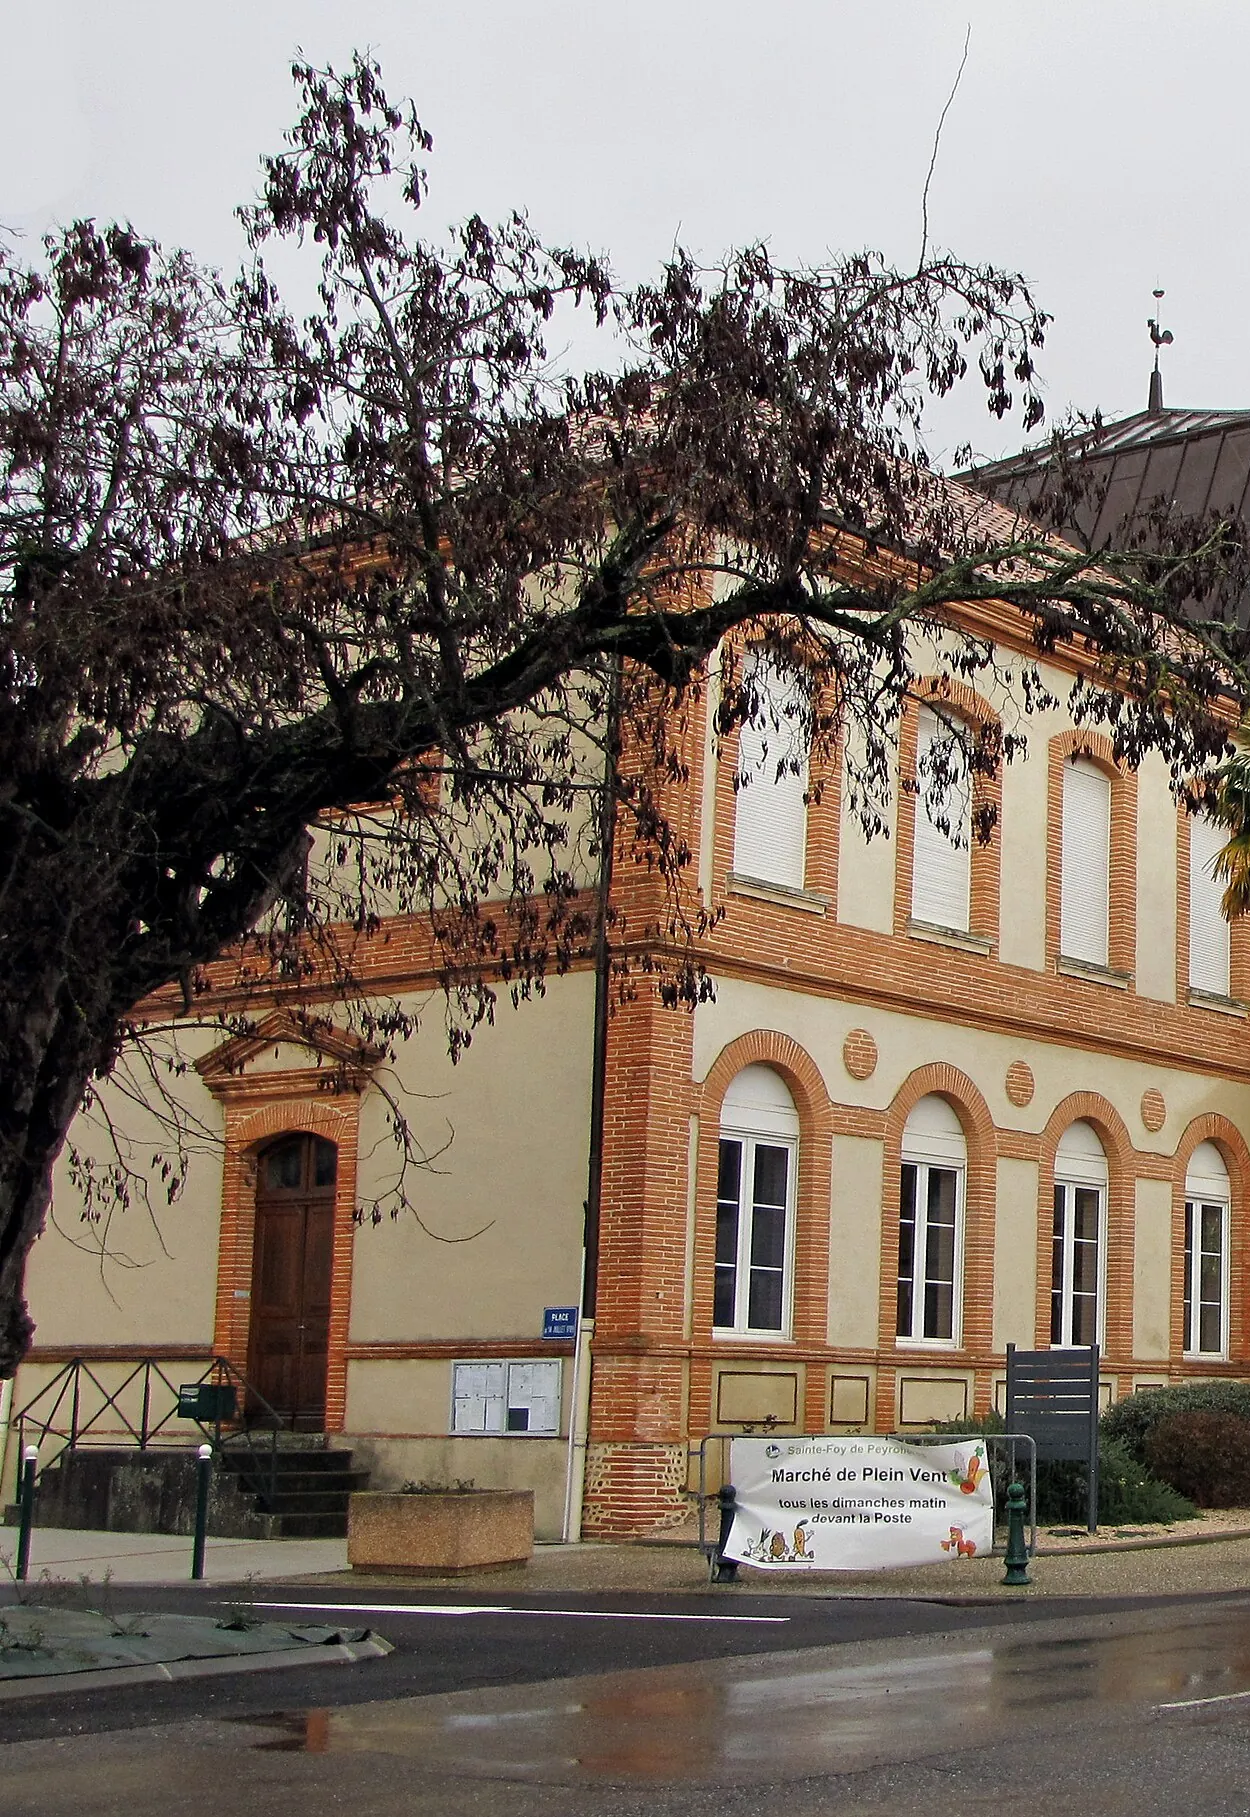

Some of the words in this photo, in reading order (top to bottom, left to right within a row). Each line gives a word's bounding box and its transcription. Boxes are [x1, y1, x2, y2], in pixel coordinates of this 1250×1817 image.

[551, 1313, 569, 1321] PLACE
[788, 1444, 846, 1456] Sainte-Foy
[850, 1444, 863, 1454] de
[772, 1467, 831, 1482] Marché
[836, 1467, 856, 1481] de
[862, 1467, 904, 1481] Plein
[910, 1467, 948, 1482] Vent
[779, 1498, 806, 1508] tous
[810, 1498, 828, 1508] les
[832, 1497, 905, 1508] dimanches
[909, 1497, 947, 1508] matin
[811, 1513, 855, 1523] devant
[859, 1513, 870, 1523] la
[874, 1513, 912, 1523] Poste
